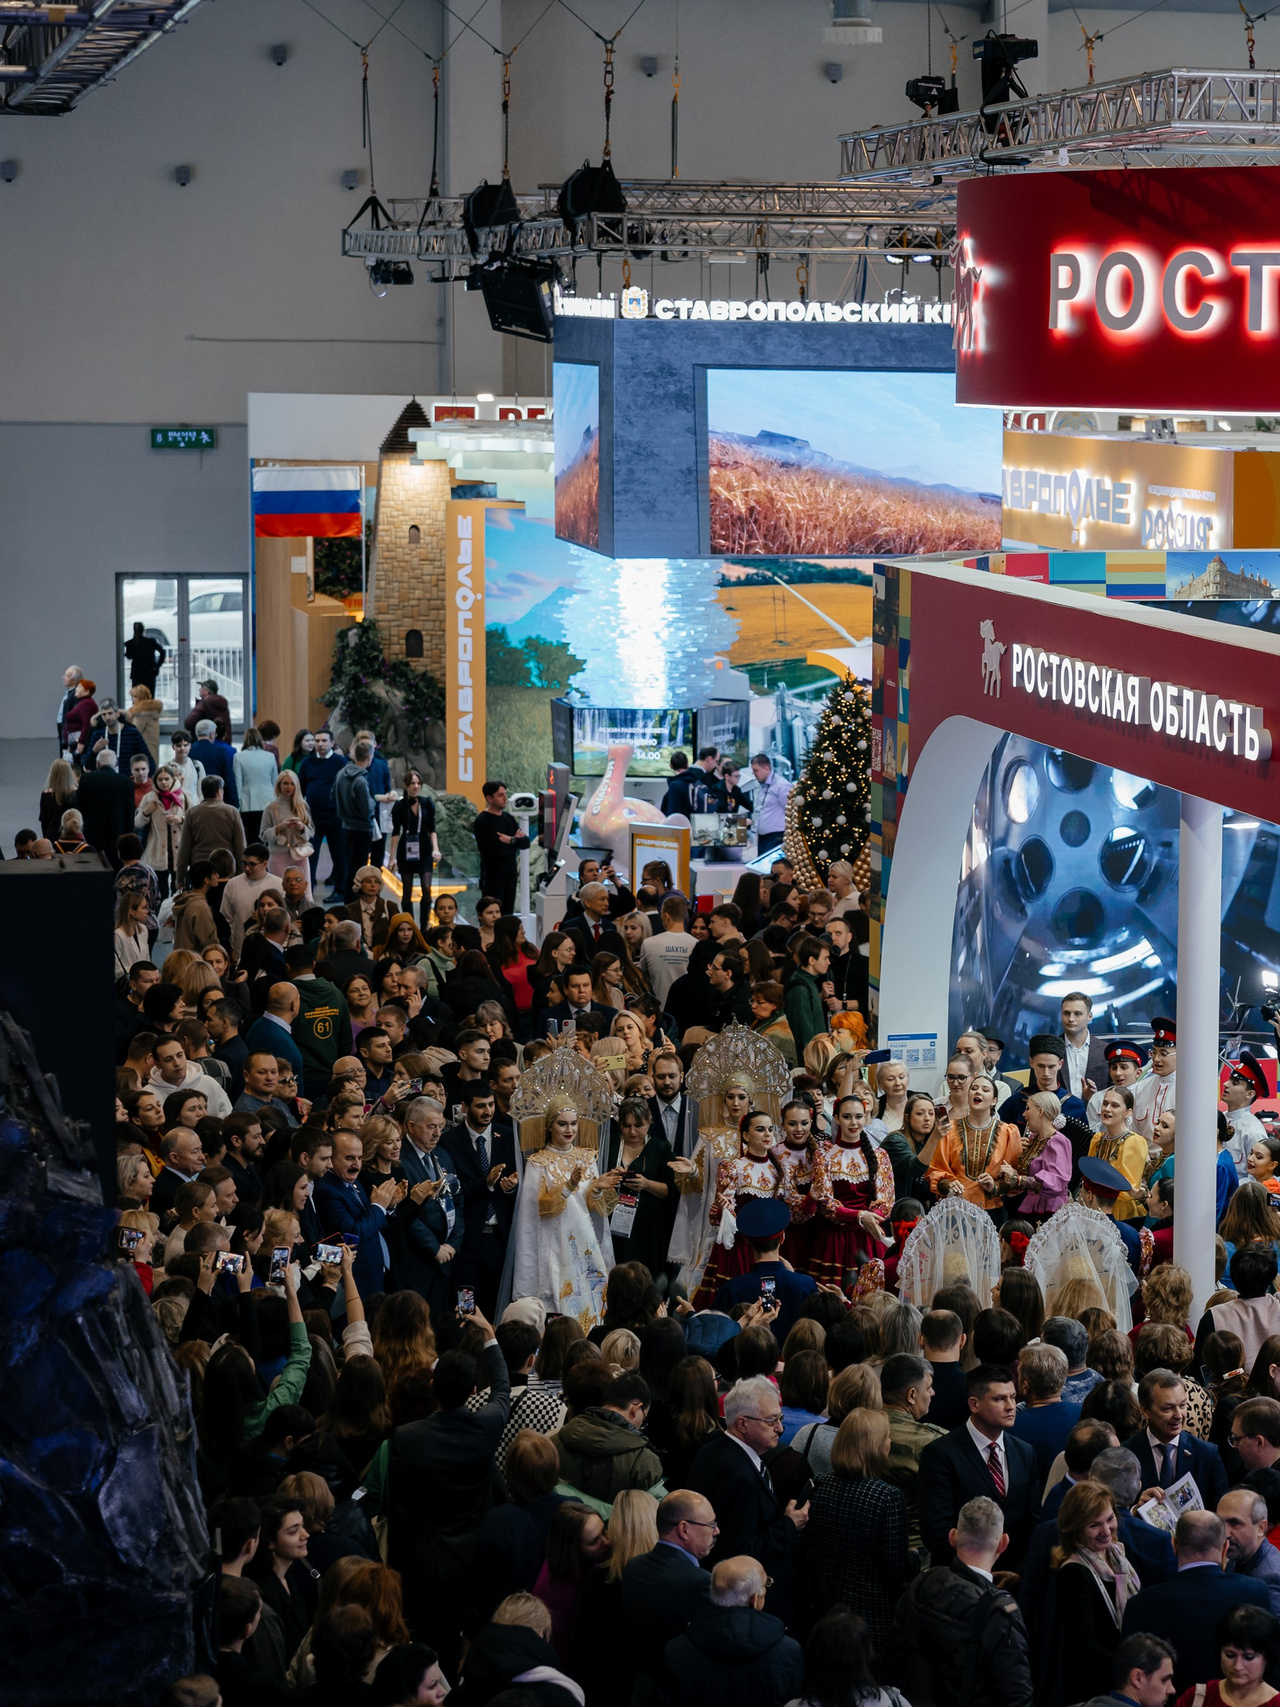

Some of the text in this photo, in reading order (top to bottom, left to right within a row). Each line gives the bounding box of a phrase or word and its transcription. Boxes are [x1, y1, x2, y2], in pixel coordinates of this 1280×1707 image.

[655, 296, 919, 323] СТАВРОПОЛЬСКИЙ
[455, 514, 482, 782] СТАВРОПОЛЬЕ
[1012, 642, 1262, 762] РОСТОВСКАЯ ОБЛАСТЬ
[665, 945, 688, 953] ШАХТЫ
[317, 1021, 330, 1033] 61
